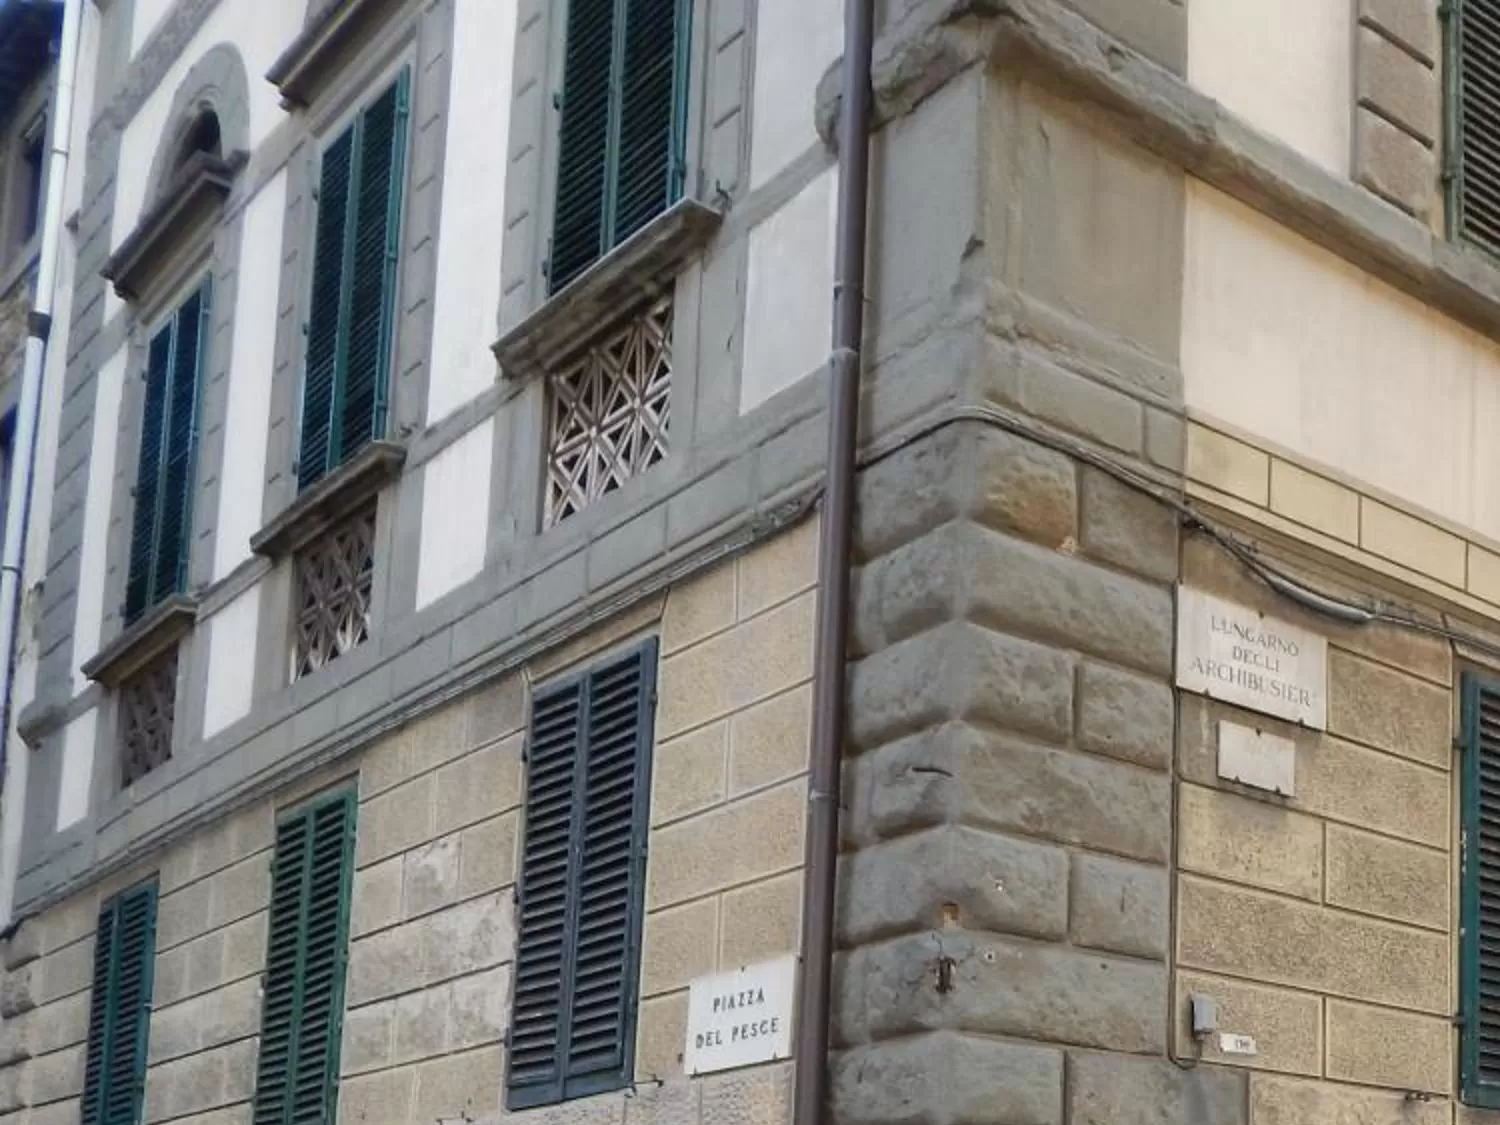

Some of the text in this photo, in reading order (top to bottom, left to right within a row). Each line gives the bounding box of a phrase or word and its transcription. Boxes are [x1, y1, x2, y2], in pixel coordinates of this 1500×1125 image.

[1211, 616, 1299, 656] LUNGARNO
[1233, 646, 1281, 672] DEGLI
[713, 987, 764, 1012] PIAZZA
[695, 1017, 780, 1049] DEL PESCE
